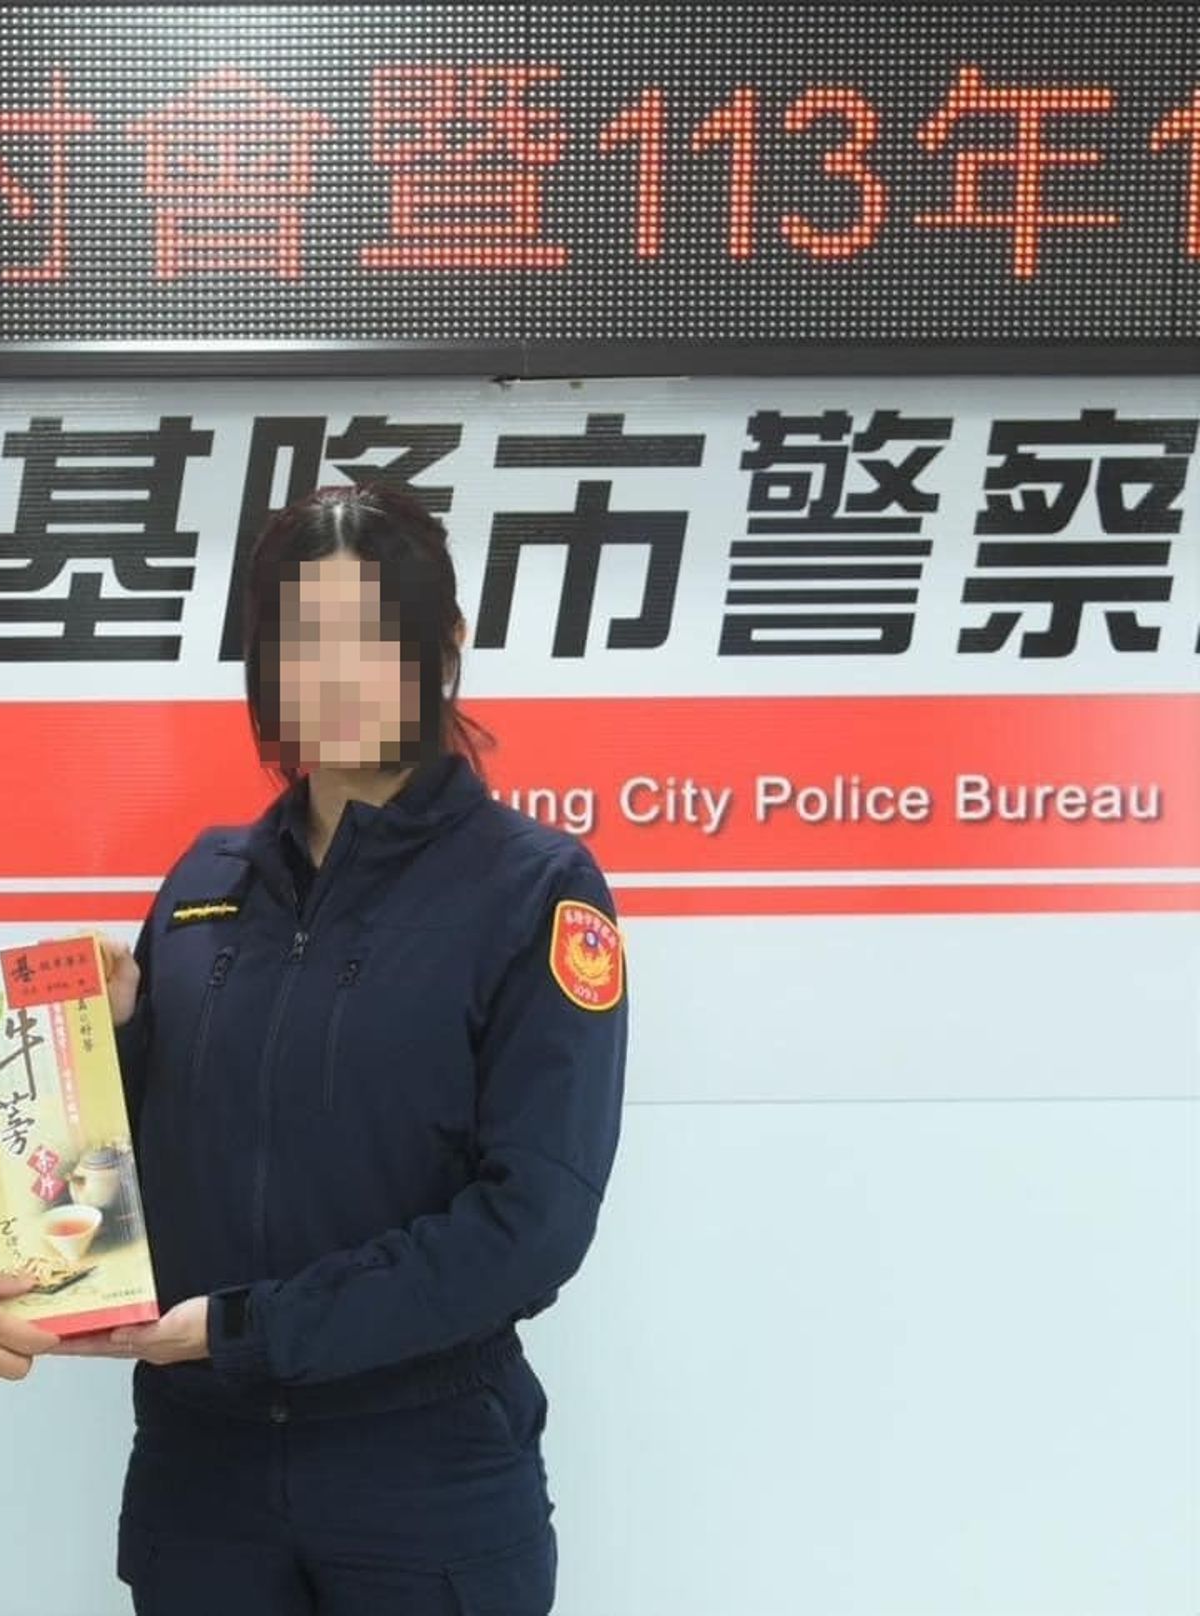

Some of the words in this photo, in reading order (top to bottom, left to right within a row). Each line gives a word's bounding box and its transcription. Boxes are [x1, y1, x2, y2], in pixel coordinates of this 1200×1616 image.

[619, 775, 732, 832] City
[754, 775, 931, 823] Police
[954, 774, 1162, 822] Bureau
